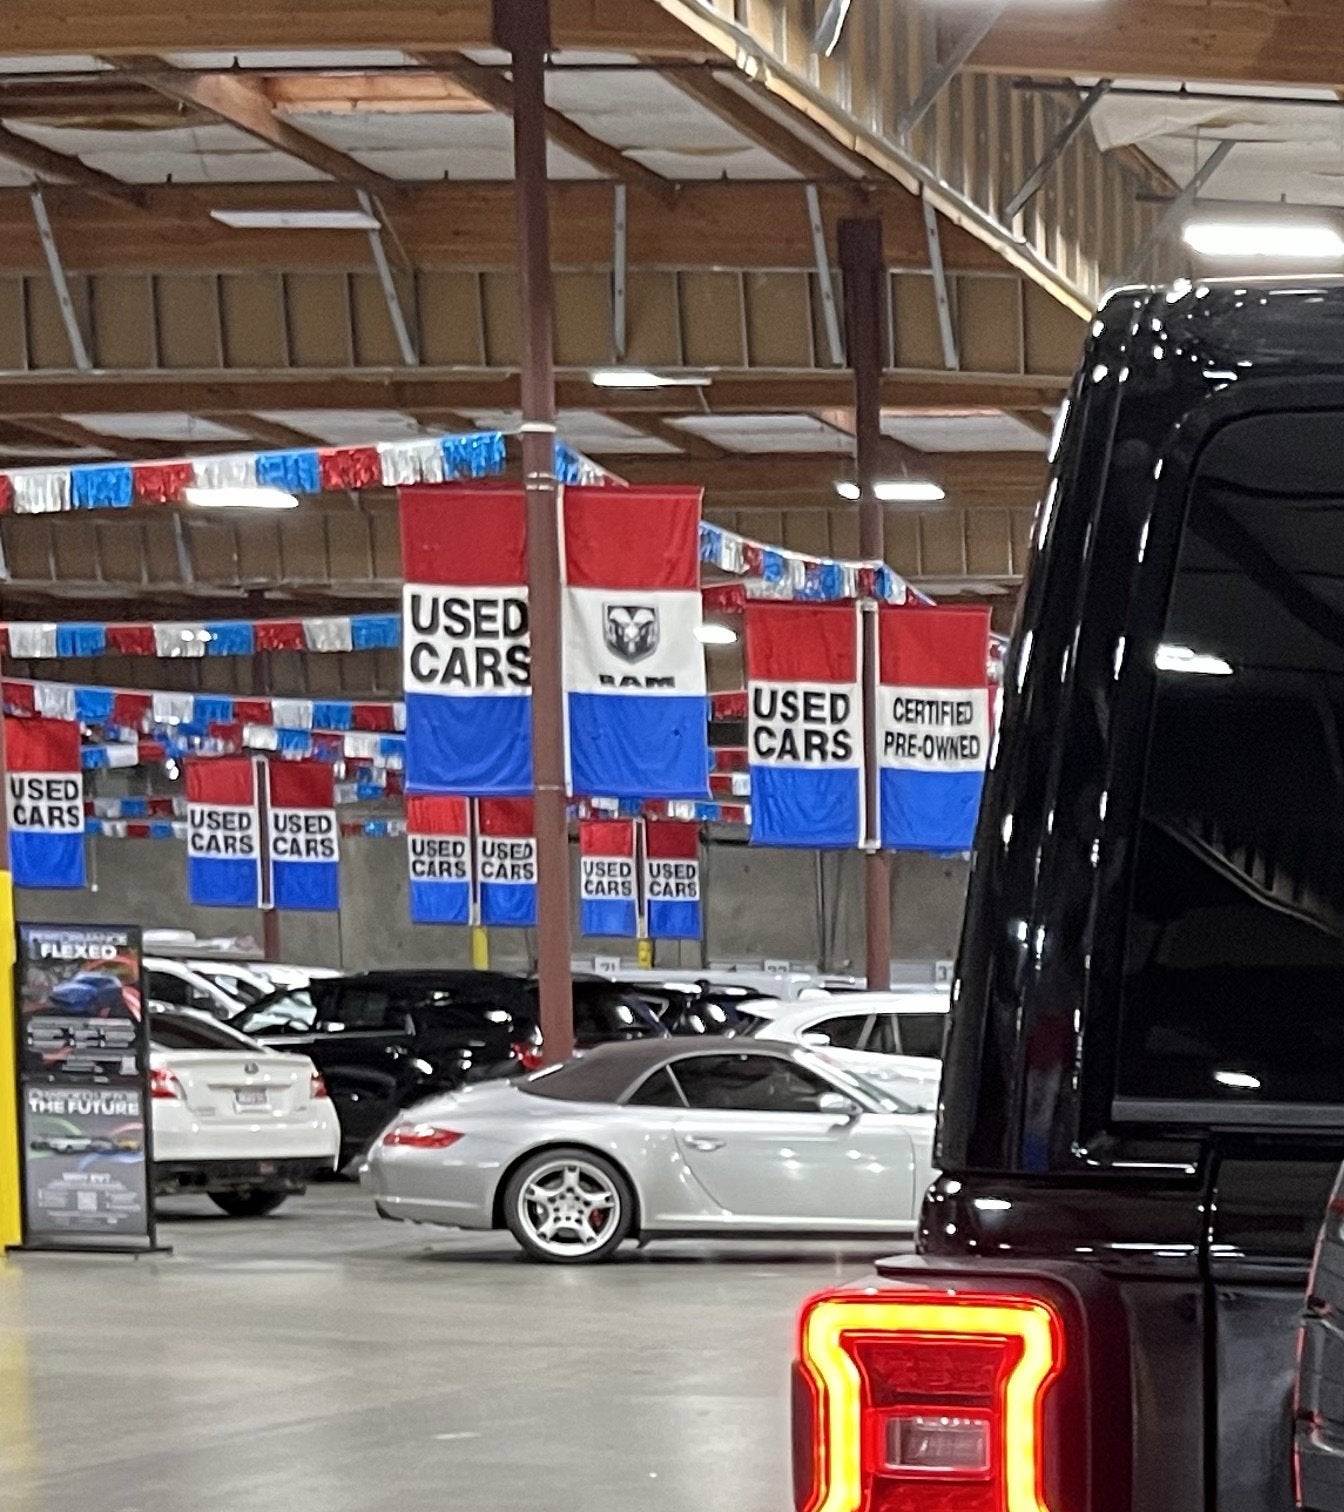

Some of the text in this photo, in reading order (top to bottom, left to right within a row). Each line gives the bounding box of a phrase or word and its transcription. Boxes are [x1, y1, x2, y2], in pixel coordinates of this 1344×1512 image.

[410, 594, 529, 640] USED
[410, 641, 531, 688] CARS
[753, 688, 851, 725] USED
[893, 697, 974, 726] CERTIFIED
[753, 726, 852, 762] CARS
[884, 731, 981, 760] PRE-OWNED
[10, 778, 80, 802] USED
[12, 803, 81, 827] CARS
[190, 809, 251, 832] USED
[273, 812, 332, 834] USED
[190, 833, 254, 855] CARS
[272, 836, 335, 858] CARS
[411, 838, 466, 858] USED
[481, 841, 533, 860] USED
[411, 859, 467, 878] CARS
[481, 861, 535, 881] CARS
[583, 861, 632, 879] USED
[650, 862, 697, 880] USED
[584, 880, 633, 897] CARS
[649, 881, 698, 898] CARS
[41, 943, 118, 960] FLEXED
[29, 1099, 140, 1116] THE FUTURE
